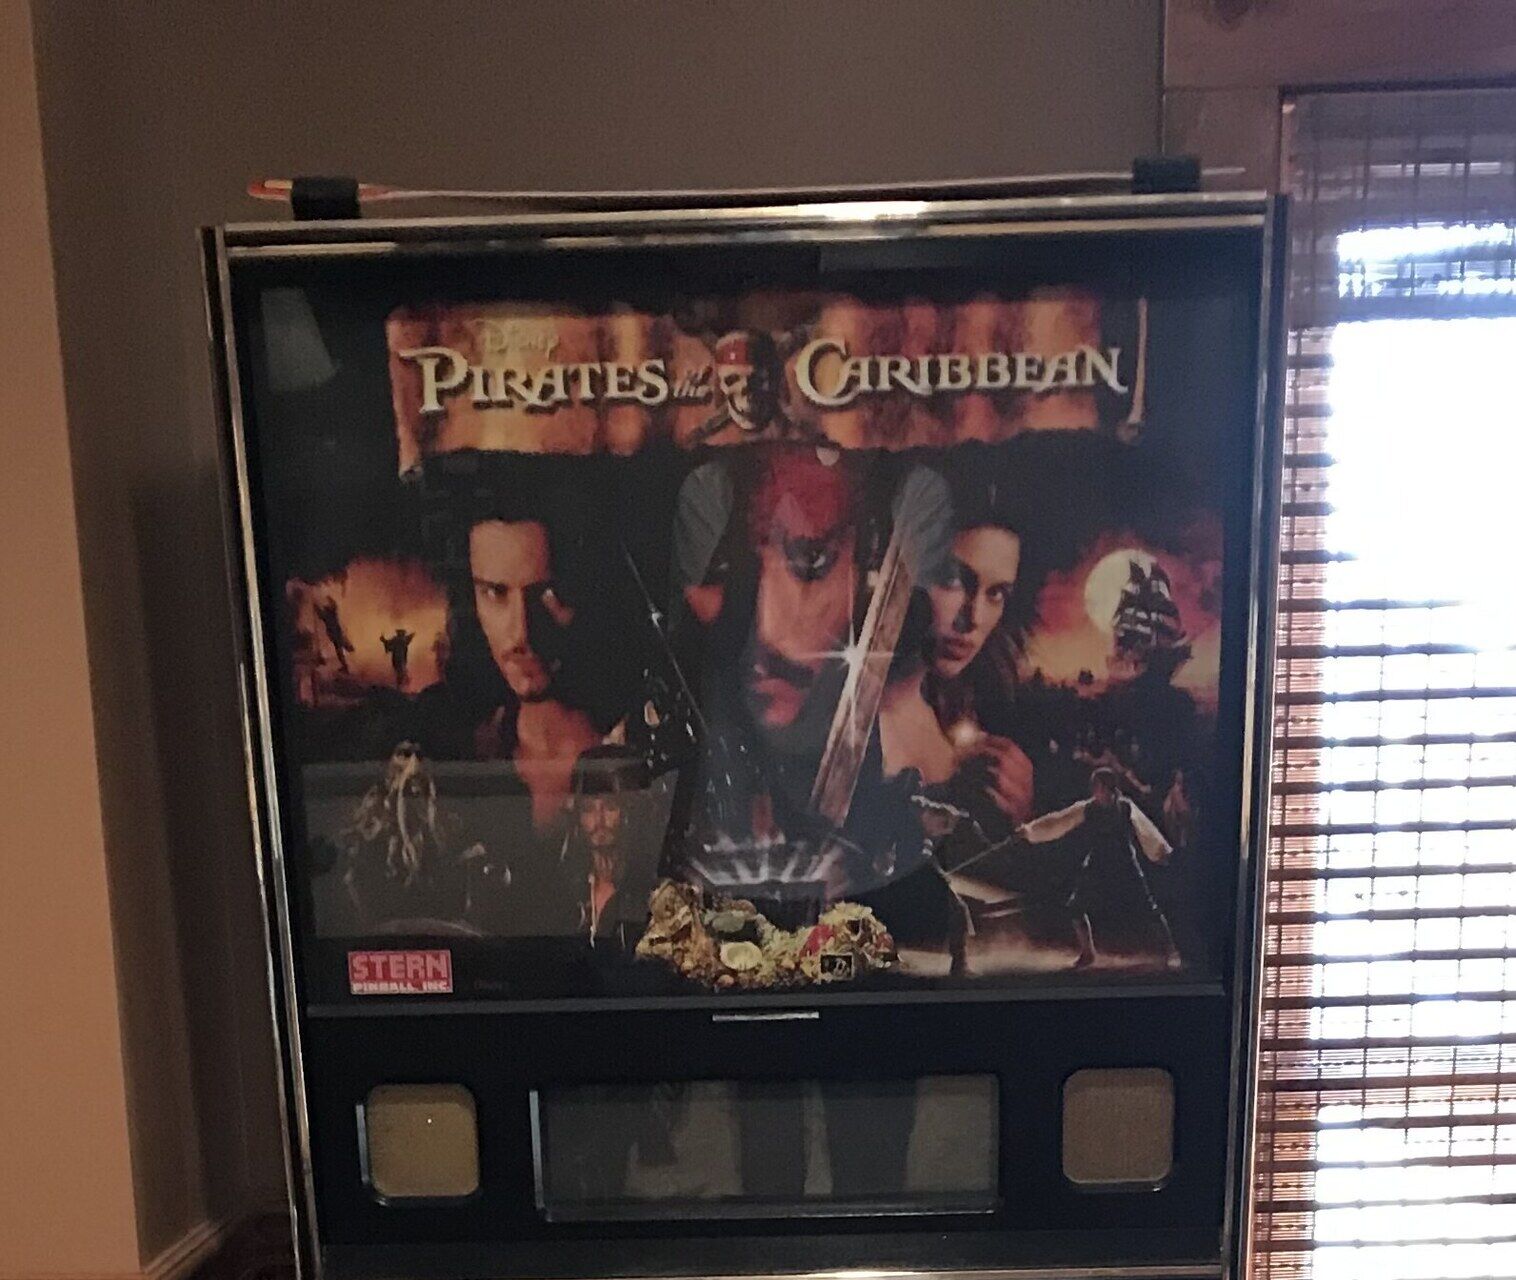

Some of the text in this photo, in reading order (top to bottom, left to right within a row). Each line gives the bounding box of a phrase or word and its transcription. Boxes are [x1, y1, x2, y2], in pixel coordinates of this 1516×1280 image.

[400, 346, 669, 414] PIRATES
[797, 339, 1128, 407] CARIBBEAN
[352, 953, 448, 979] STERN
